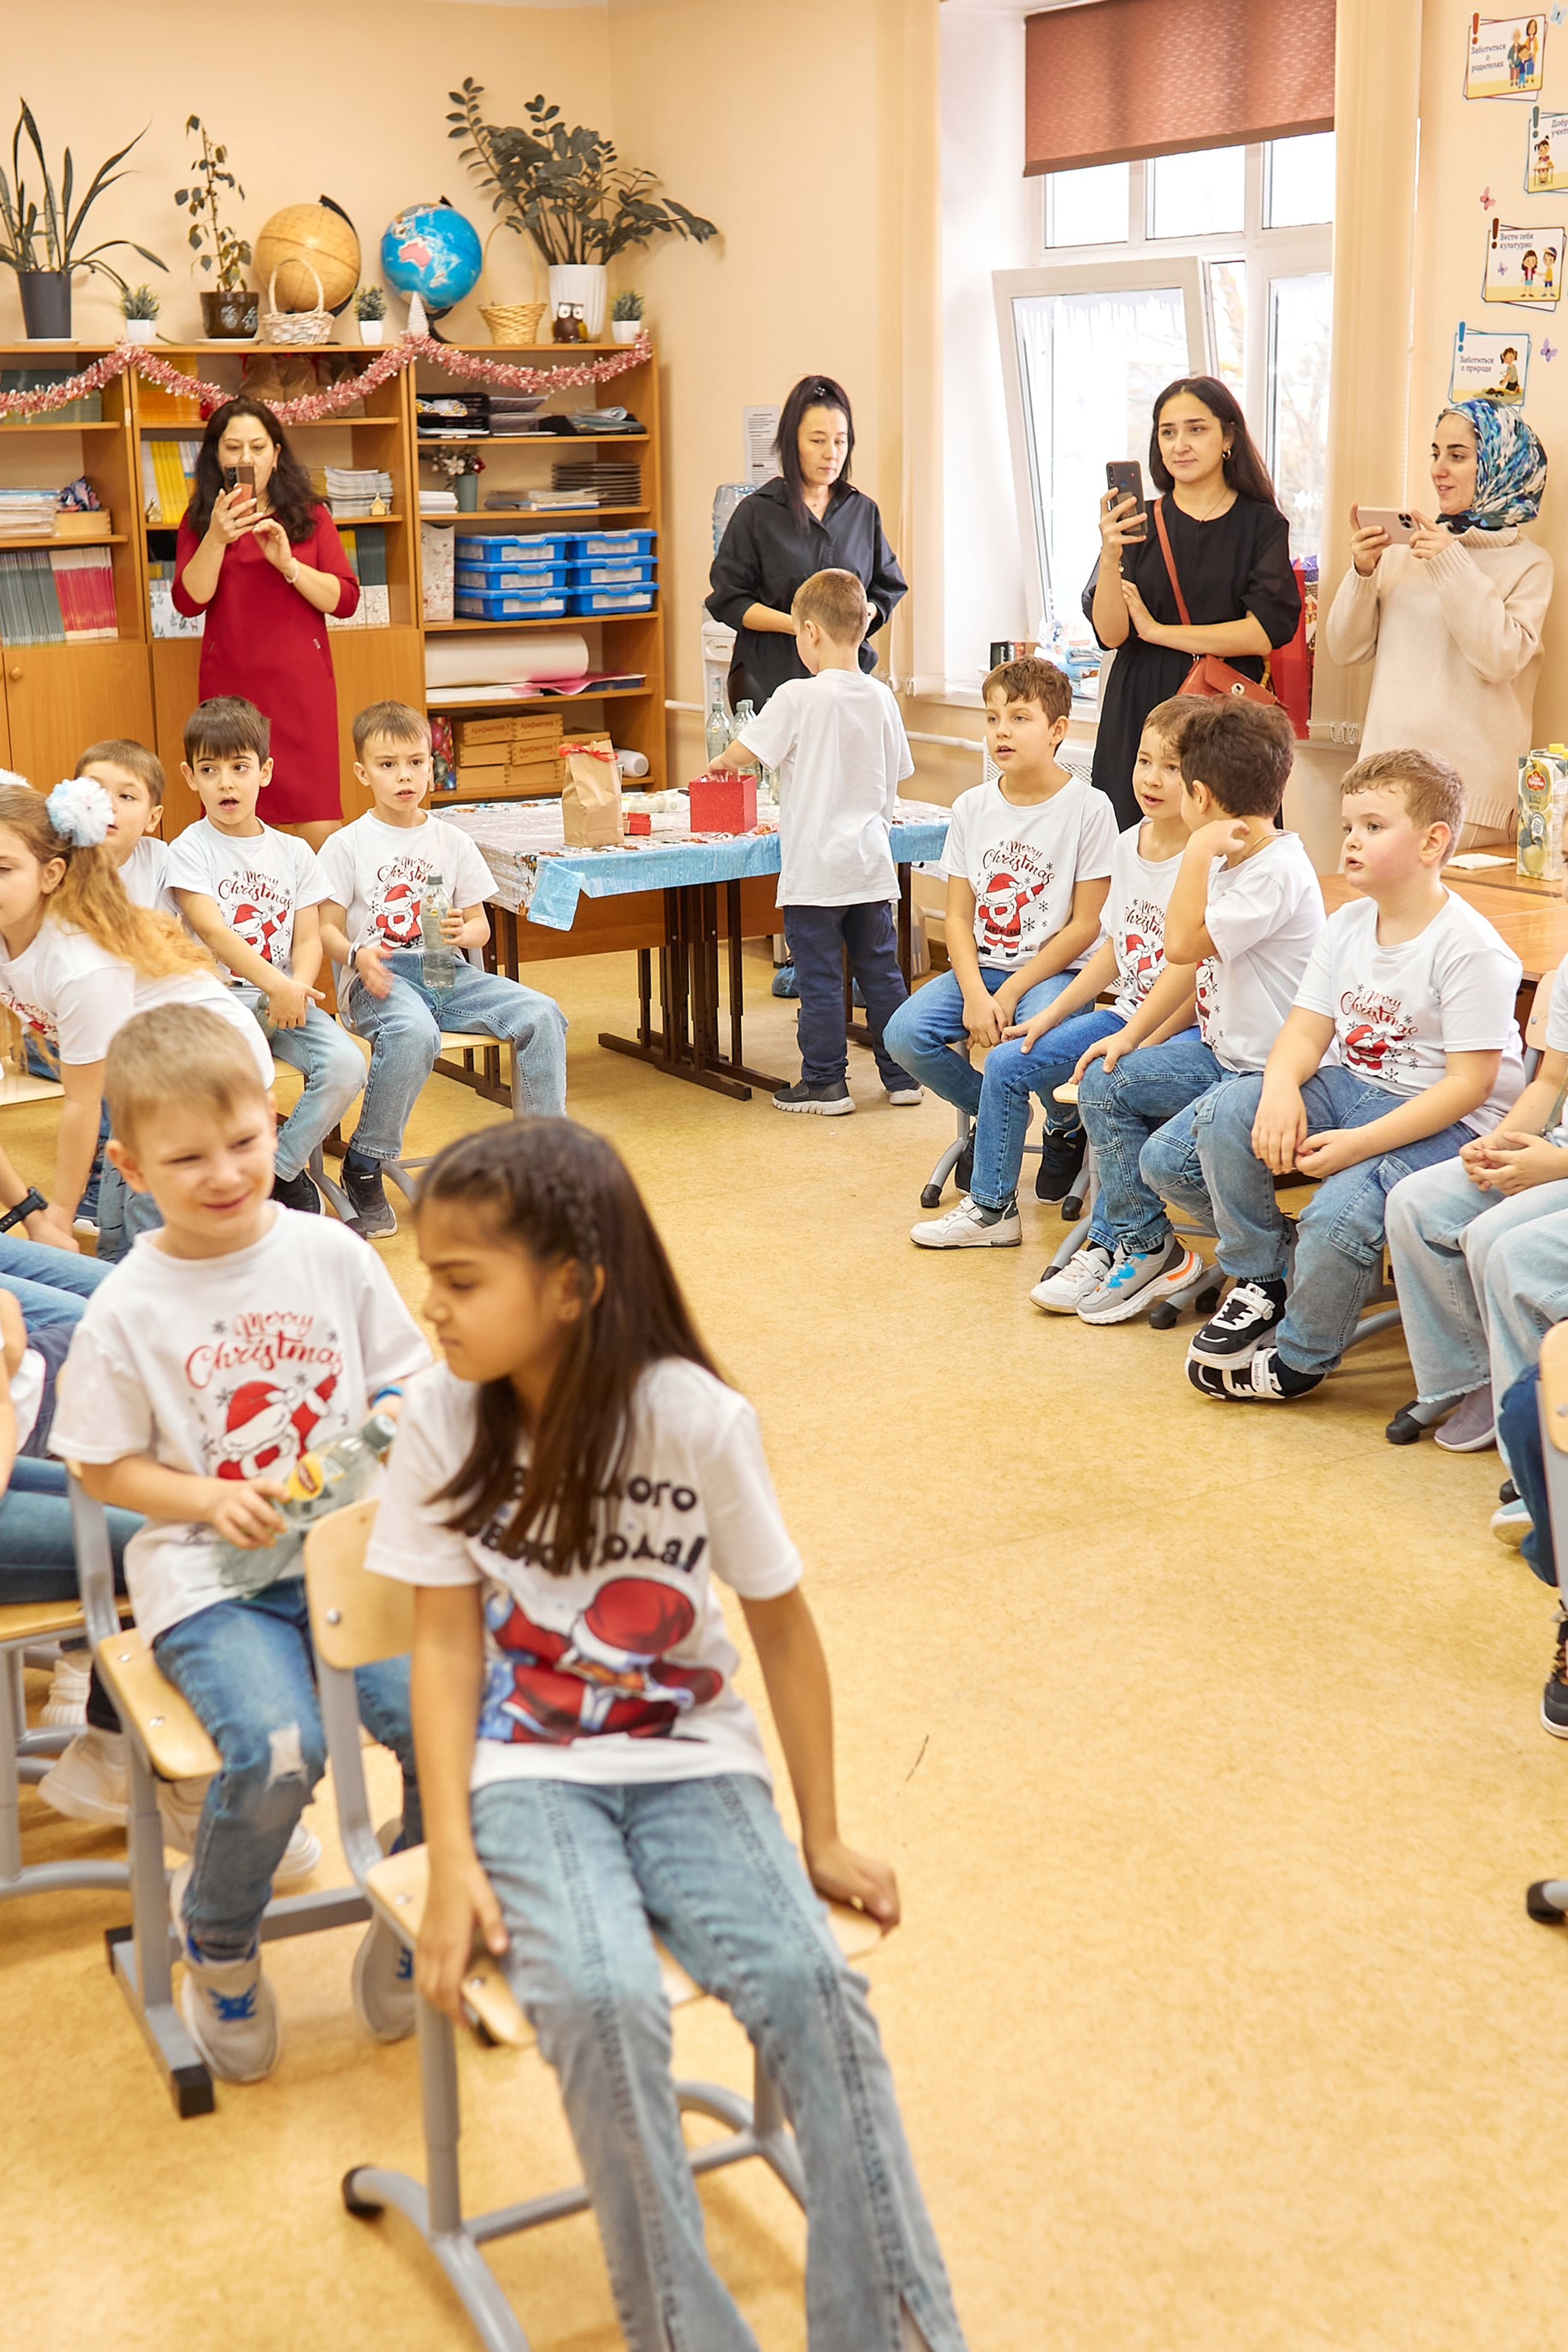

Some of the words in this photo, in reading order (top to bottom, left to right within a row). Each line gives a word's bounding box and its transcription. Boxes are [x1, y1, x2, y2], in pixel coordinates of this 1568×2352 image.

[1460, 355, 1494, 364] Заботиться
[1006, 840, 1043, 861] Merry
[242, 870, 279, 889] Merry
[982, 849, 1055, 885] Christmas
[218, 879, 293, 910] Christmas
[233, 1310, 314, 1340] Merry
[186, 1329, 342, 1389] Christmas
